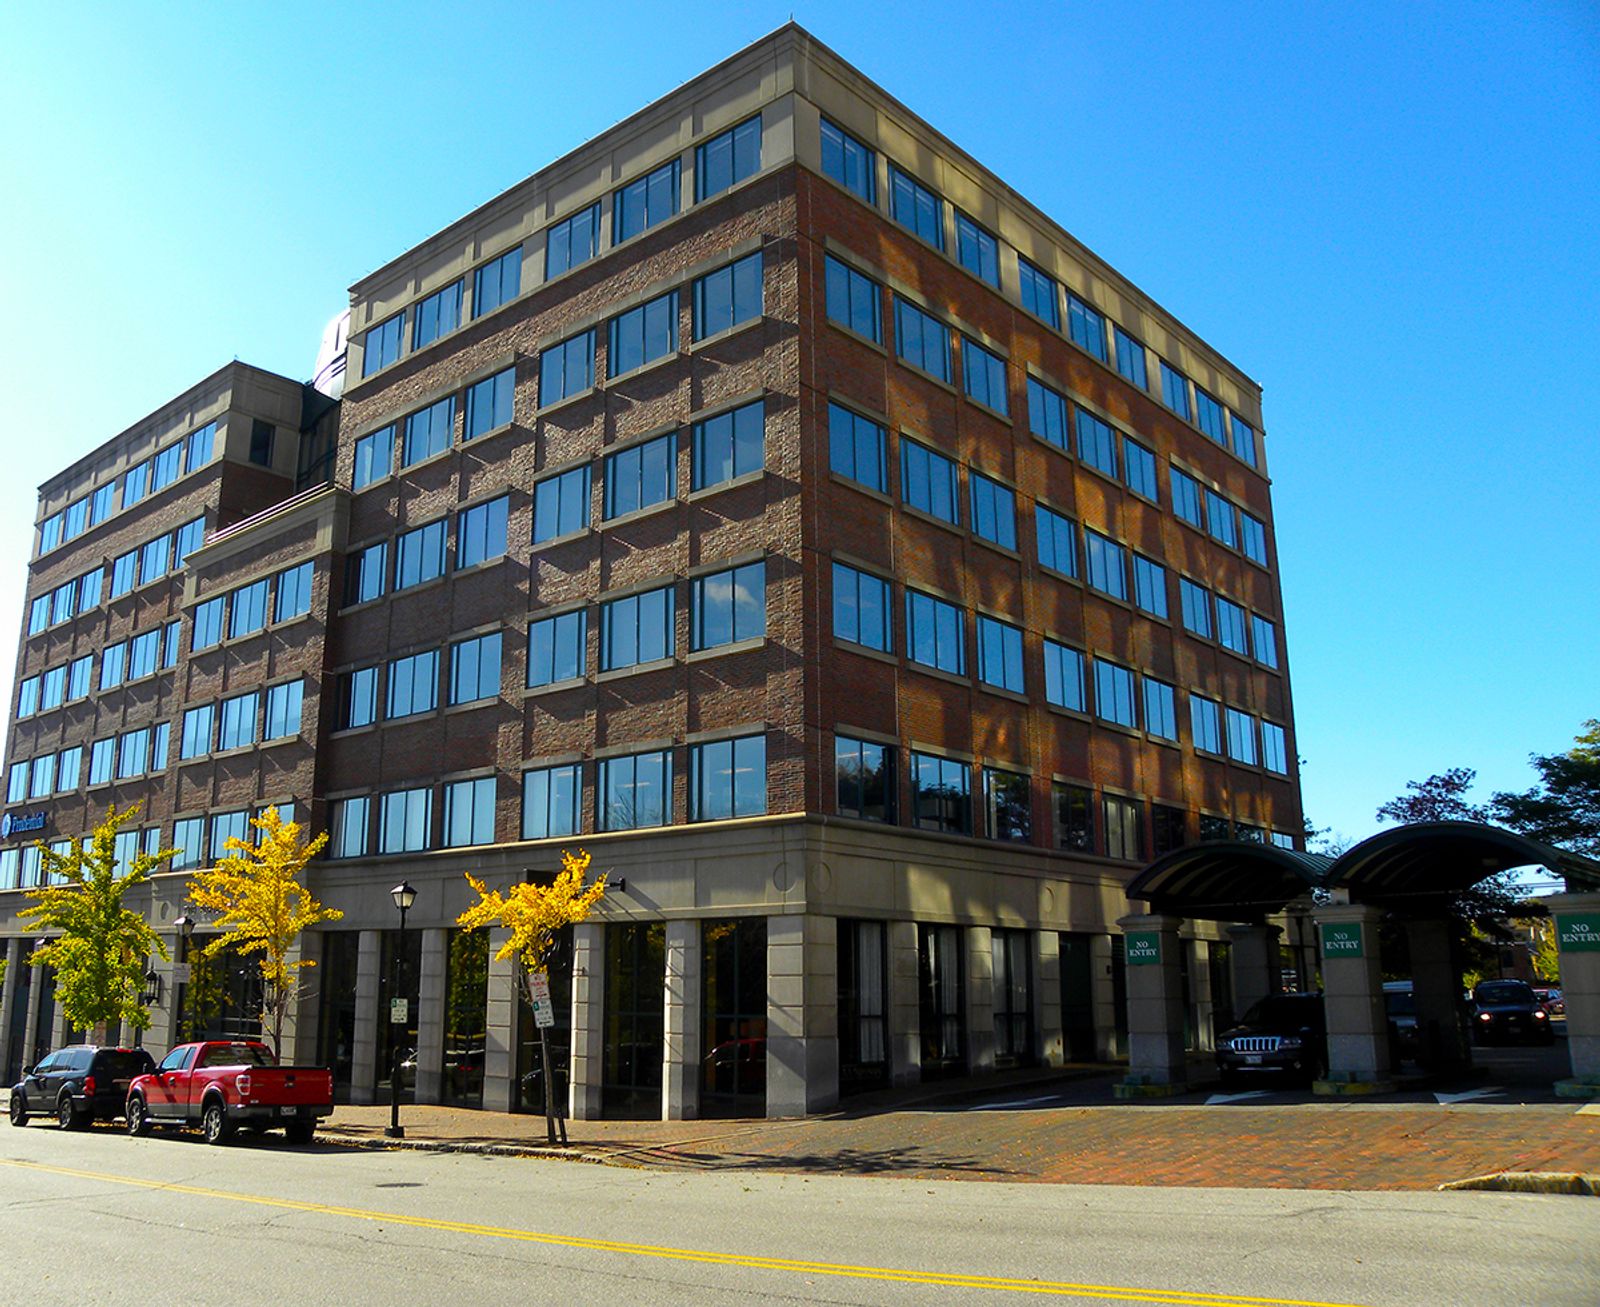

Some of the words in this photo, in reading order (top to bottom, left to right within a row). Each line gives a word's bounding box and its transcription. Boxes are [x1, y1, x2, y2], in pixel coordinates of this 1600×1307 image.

[1571, 923, 1589, 933] NO
[1333, 931, 1348, 941] NO
[1136, 941, 1149, 949] NO
[1326, 941, 1359, 950] ENTRY
[1129, 948, 1157, 957] ENTRY
